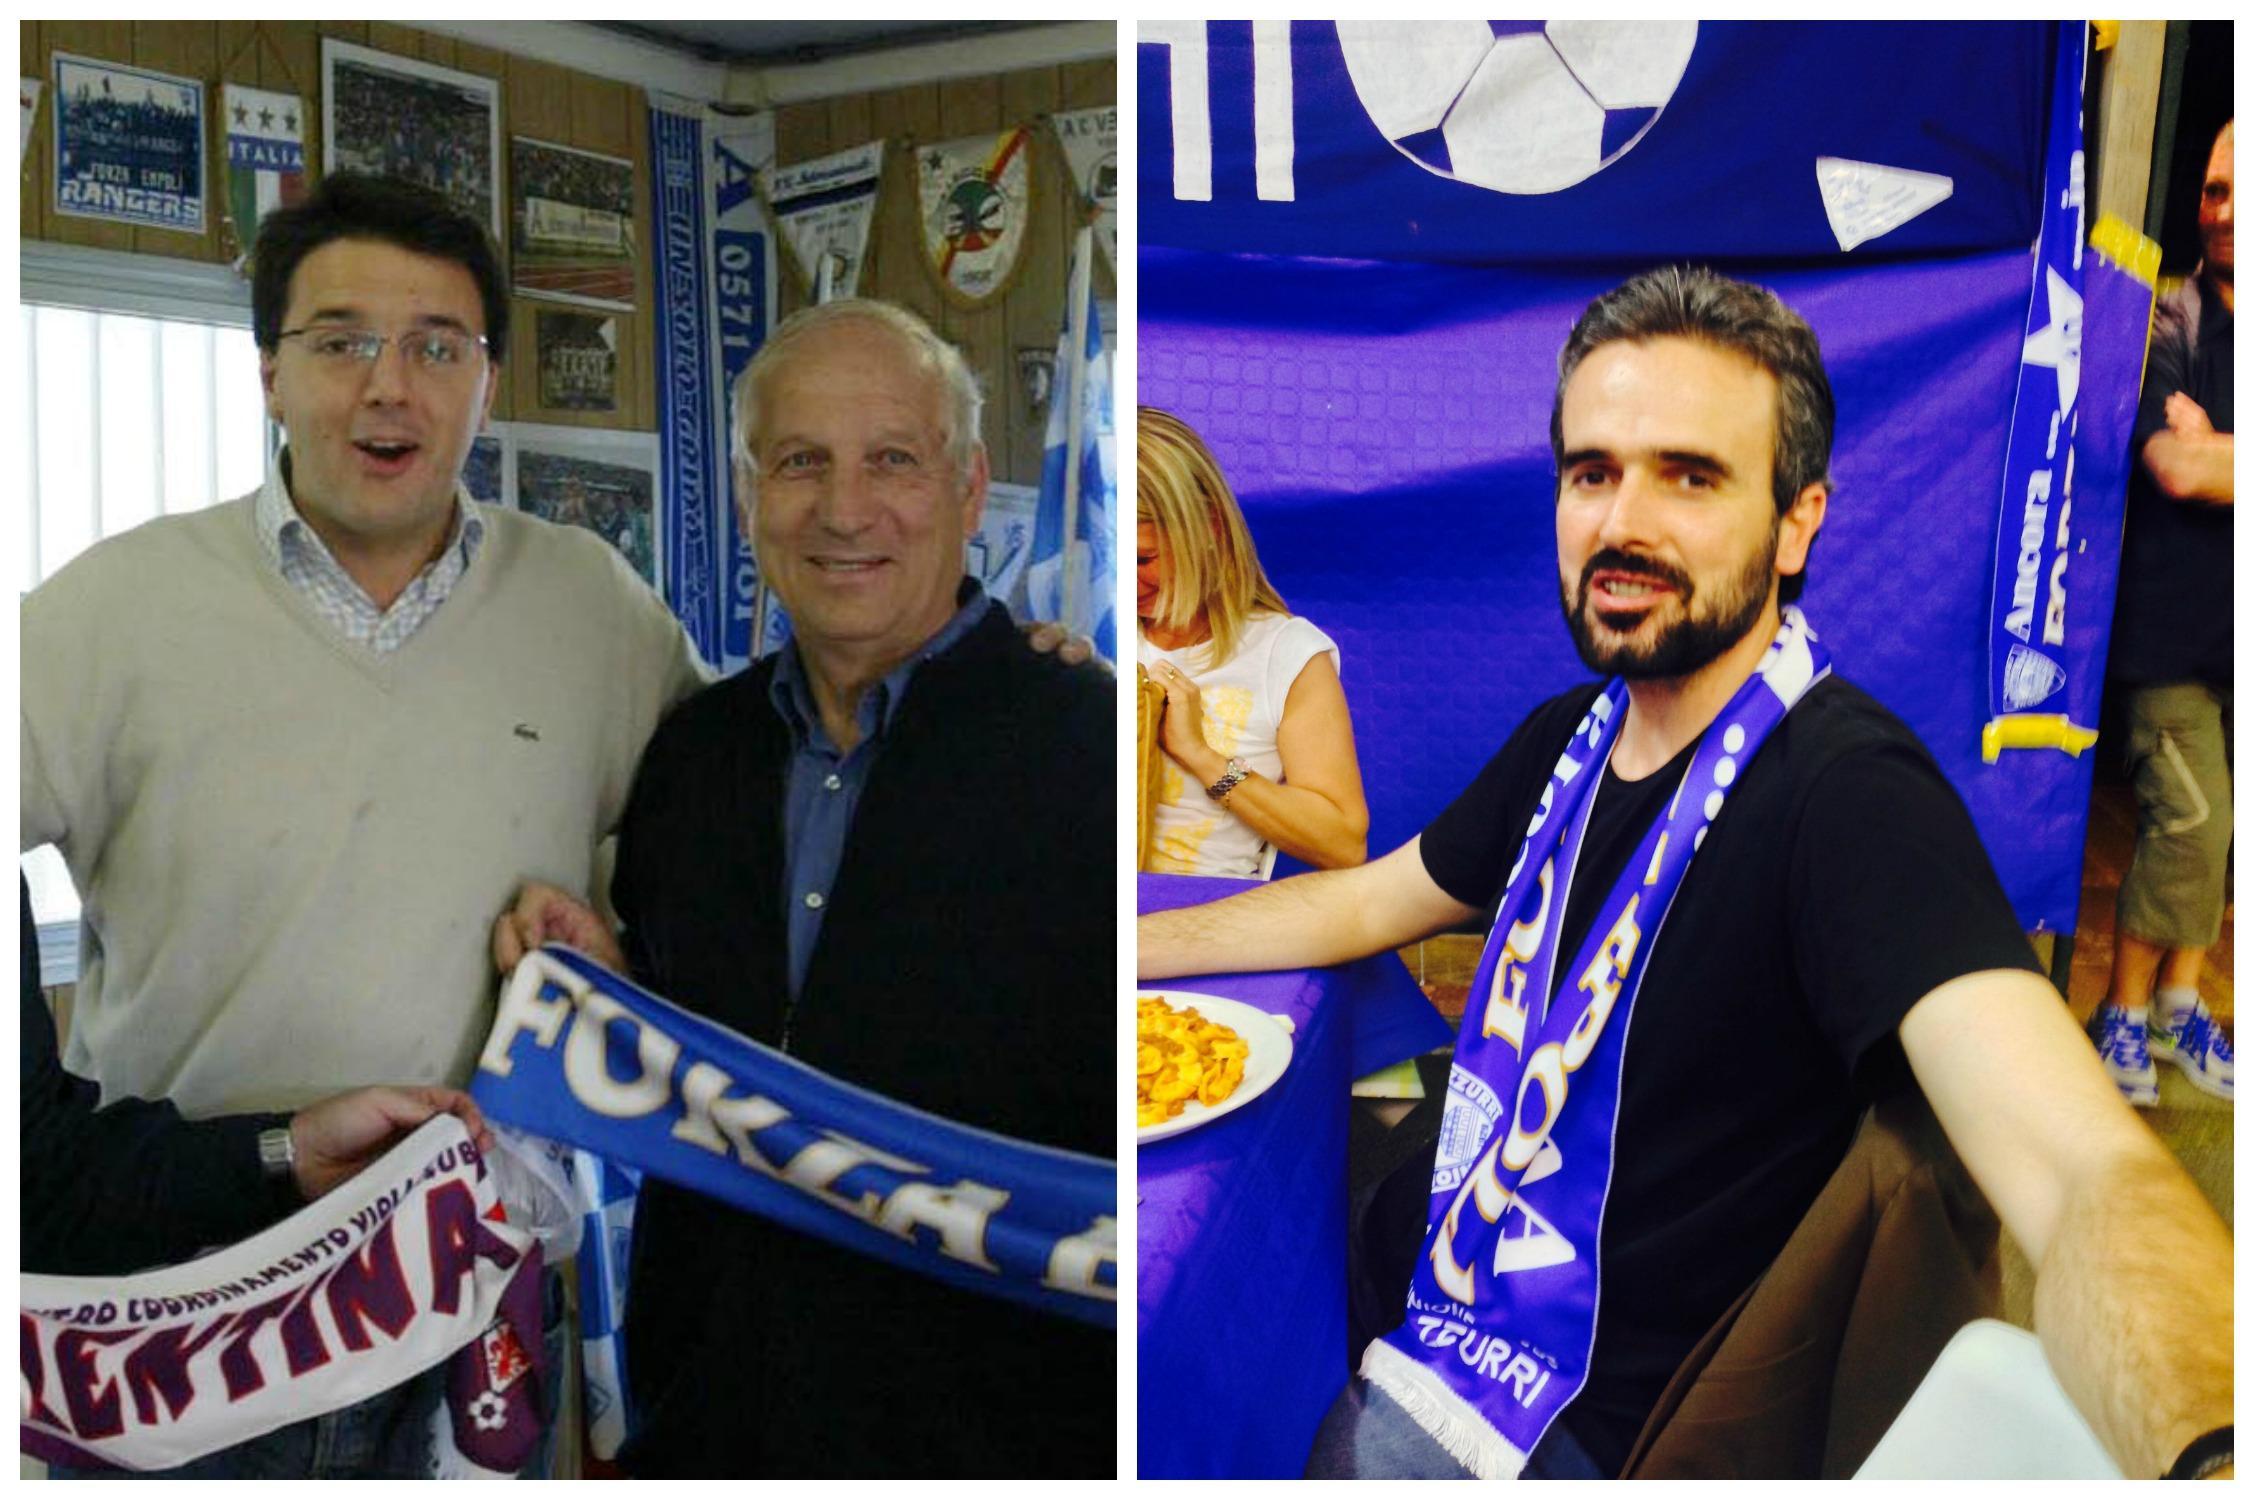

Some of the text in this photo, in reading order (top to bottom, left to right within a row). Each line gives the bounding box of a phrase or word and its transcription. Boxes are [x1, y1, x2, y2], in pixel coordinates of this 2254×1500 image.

[228, 141, 303, 167] ITALIA
[61, 178, 201, 220] RANGERS
[717, 245, 751, 347] 0571
[2004, 469, 2052, 645] Ancora
